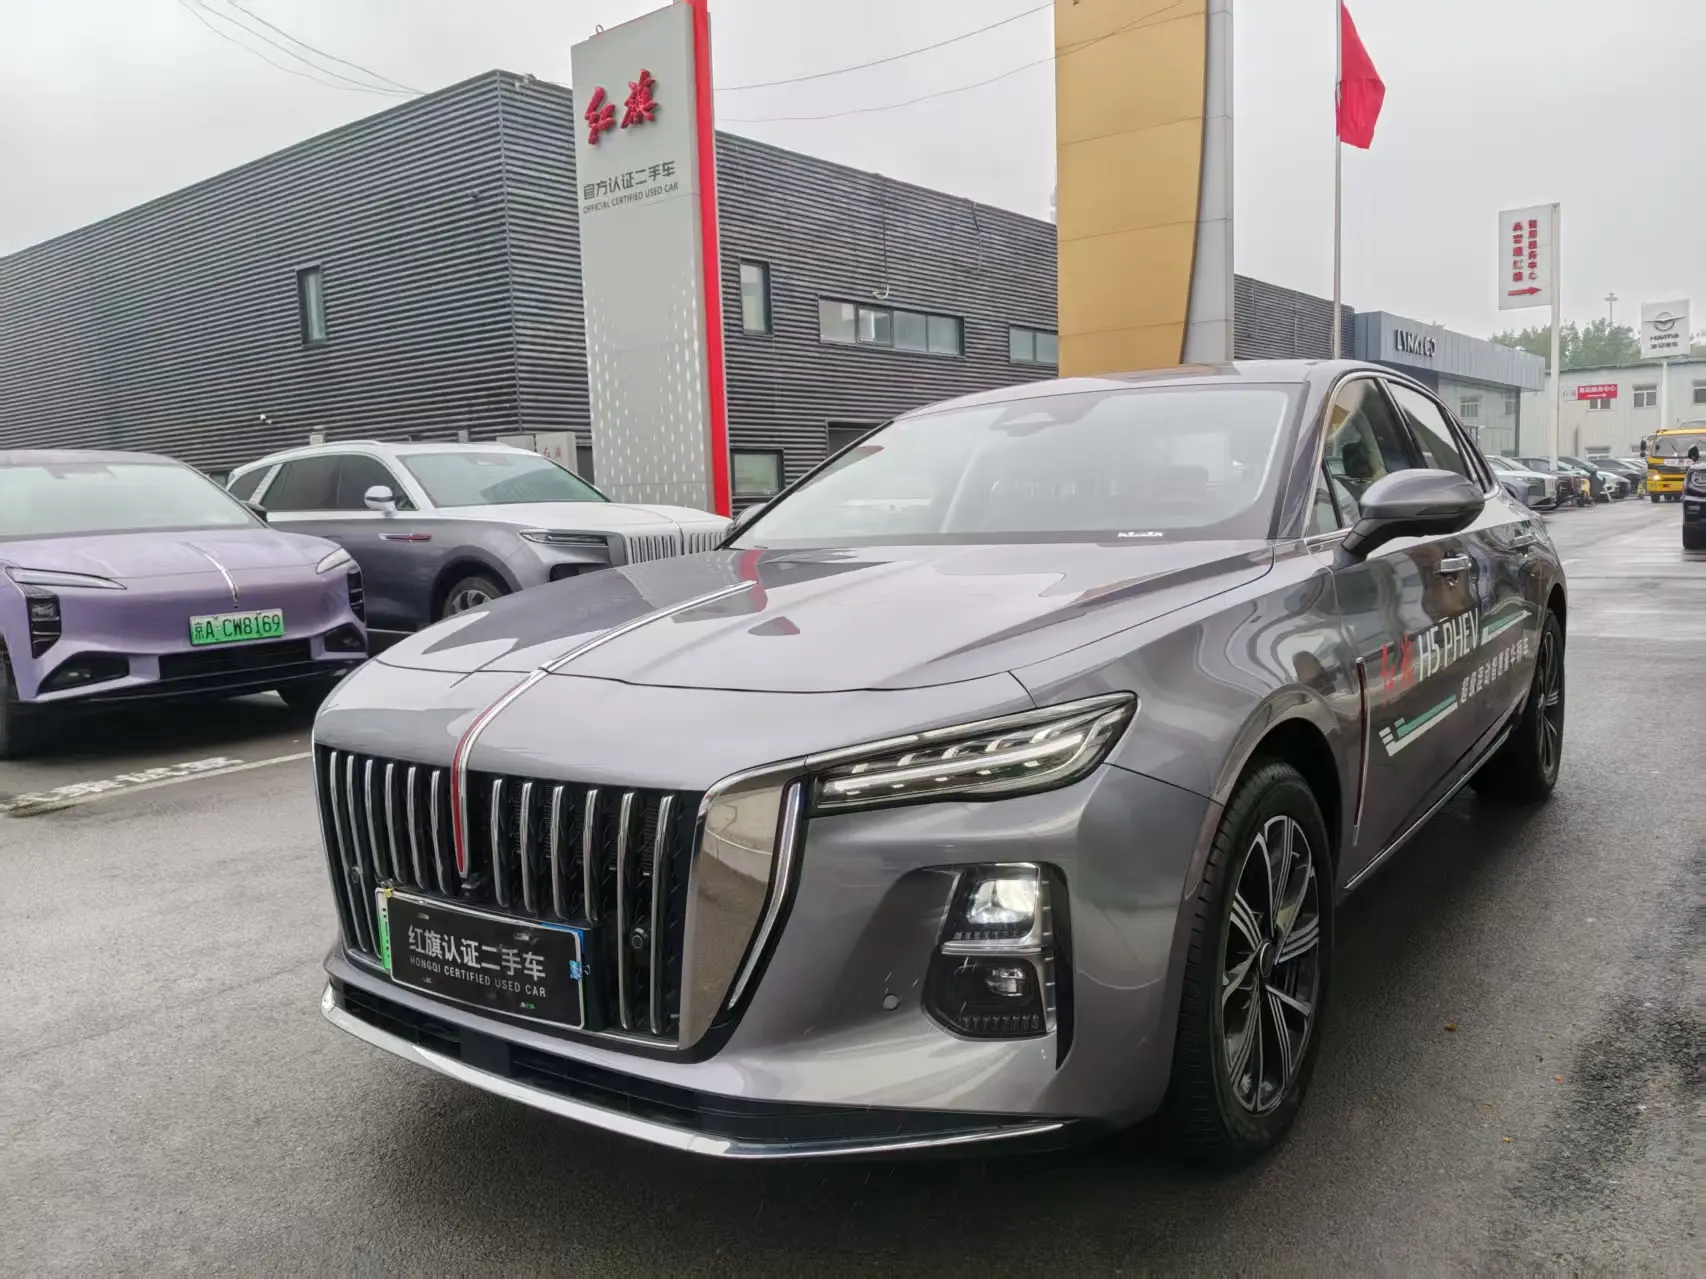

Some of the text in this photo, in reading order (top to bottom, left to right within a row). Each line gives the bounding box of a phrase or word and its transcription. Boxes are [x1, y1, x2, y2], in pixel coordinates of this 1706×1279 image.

[585, 68, 658, 145] 红旗
[583, 160, 676, 200] 官方认证二手车
[583, 181, 679, 214] OFFICIAL CERTIFIED USED CAR
[1418, 626, 1440, 682] H5
[1443, 607, 1479, 668] PHEV
[408, 925, 546, 982] 红旗认证二手车
[410, 957, 546, 997] HONGQI CERTIFIED USED CAR
